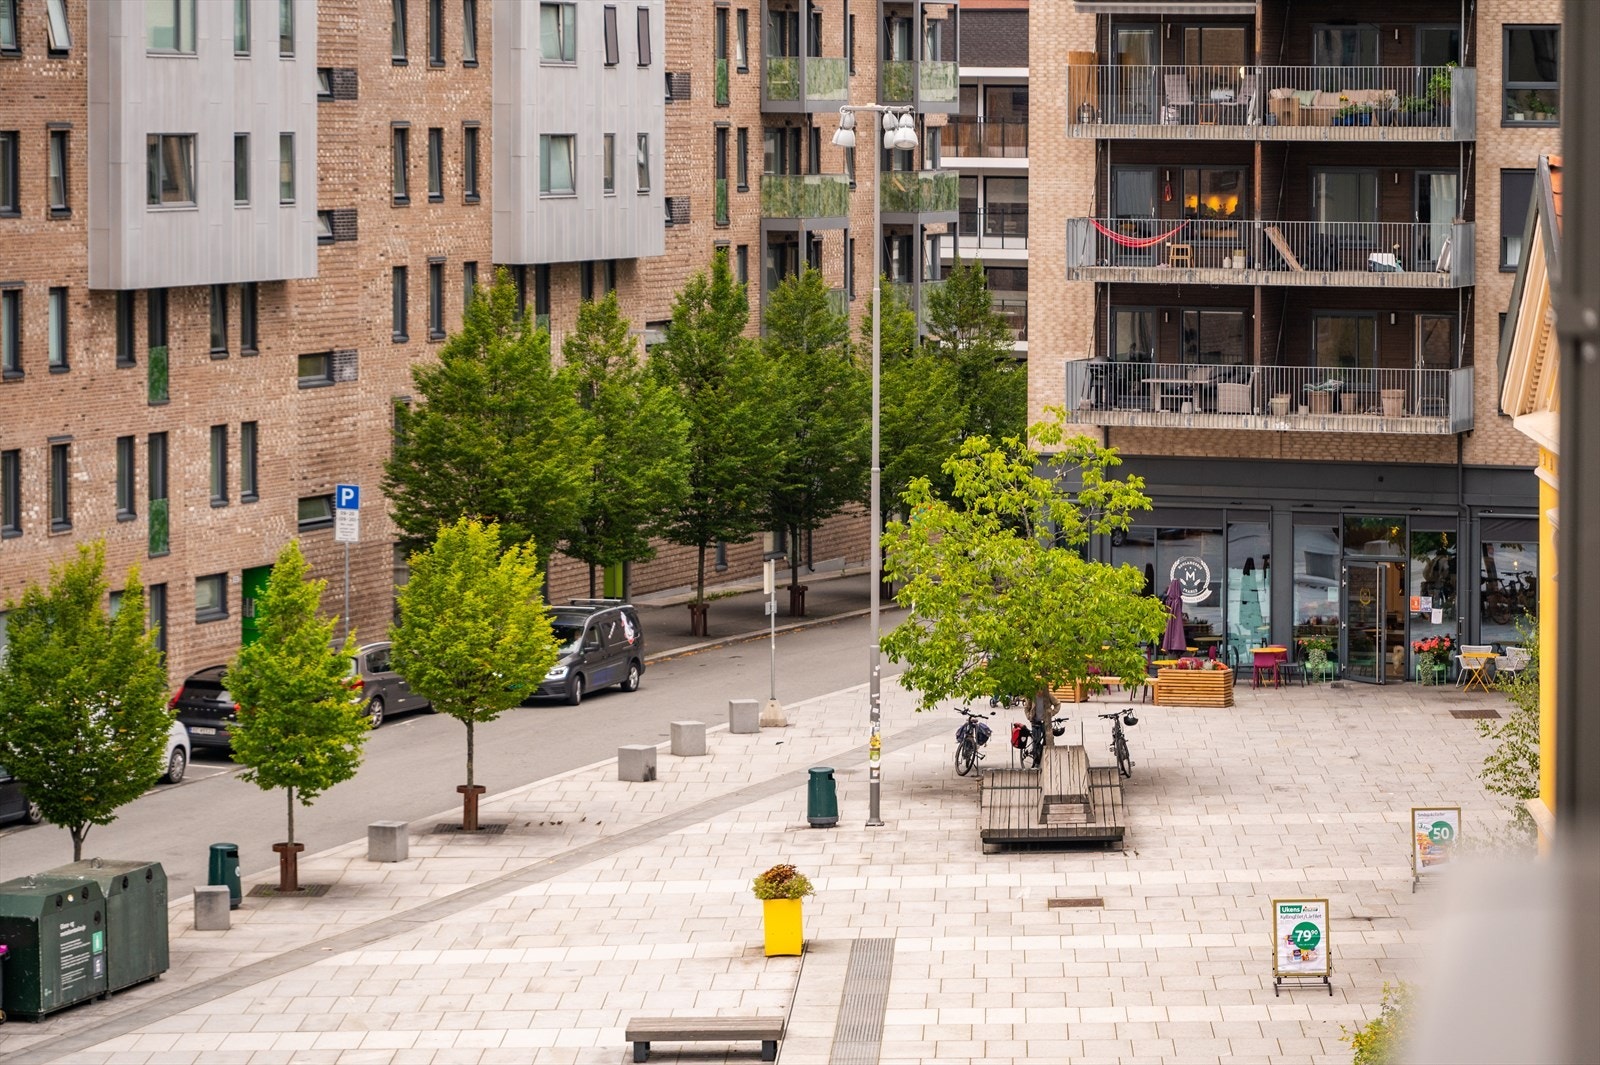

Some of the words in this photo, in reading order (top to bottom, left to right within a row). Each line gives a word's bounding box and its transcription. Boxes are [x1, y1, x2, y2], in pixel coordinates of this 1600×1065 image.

[342, 488, 354, 506] P
[1185, 571, 1196, 581] M
[1433, 827, 1450, 840] 50
